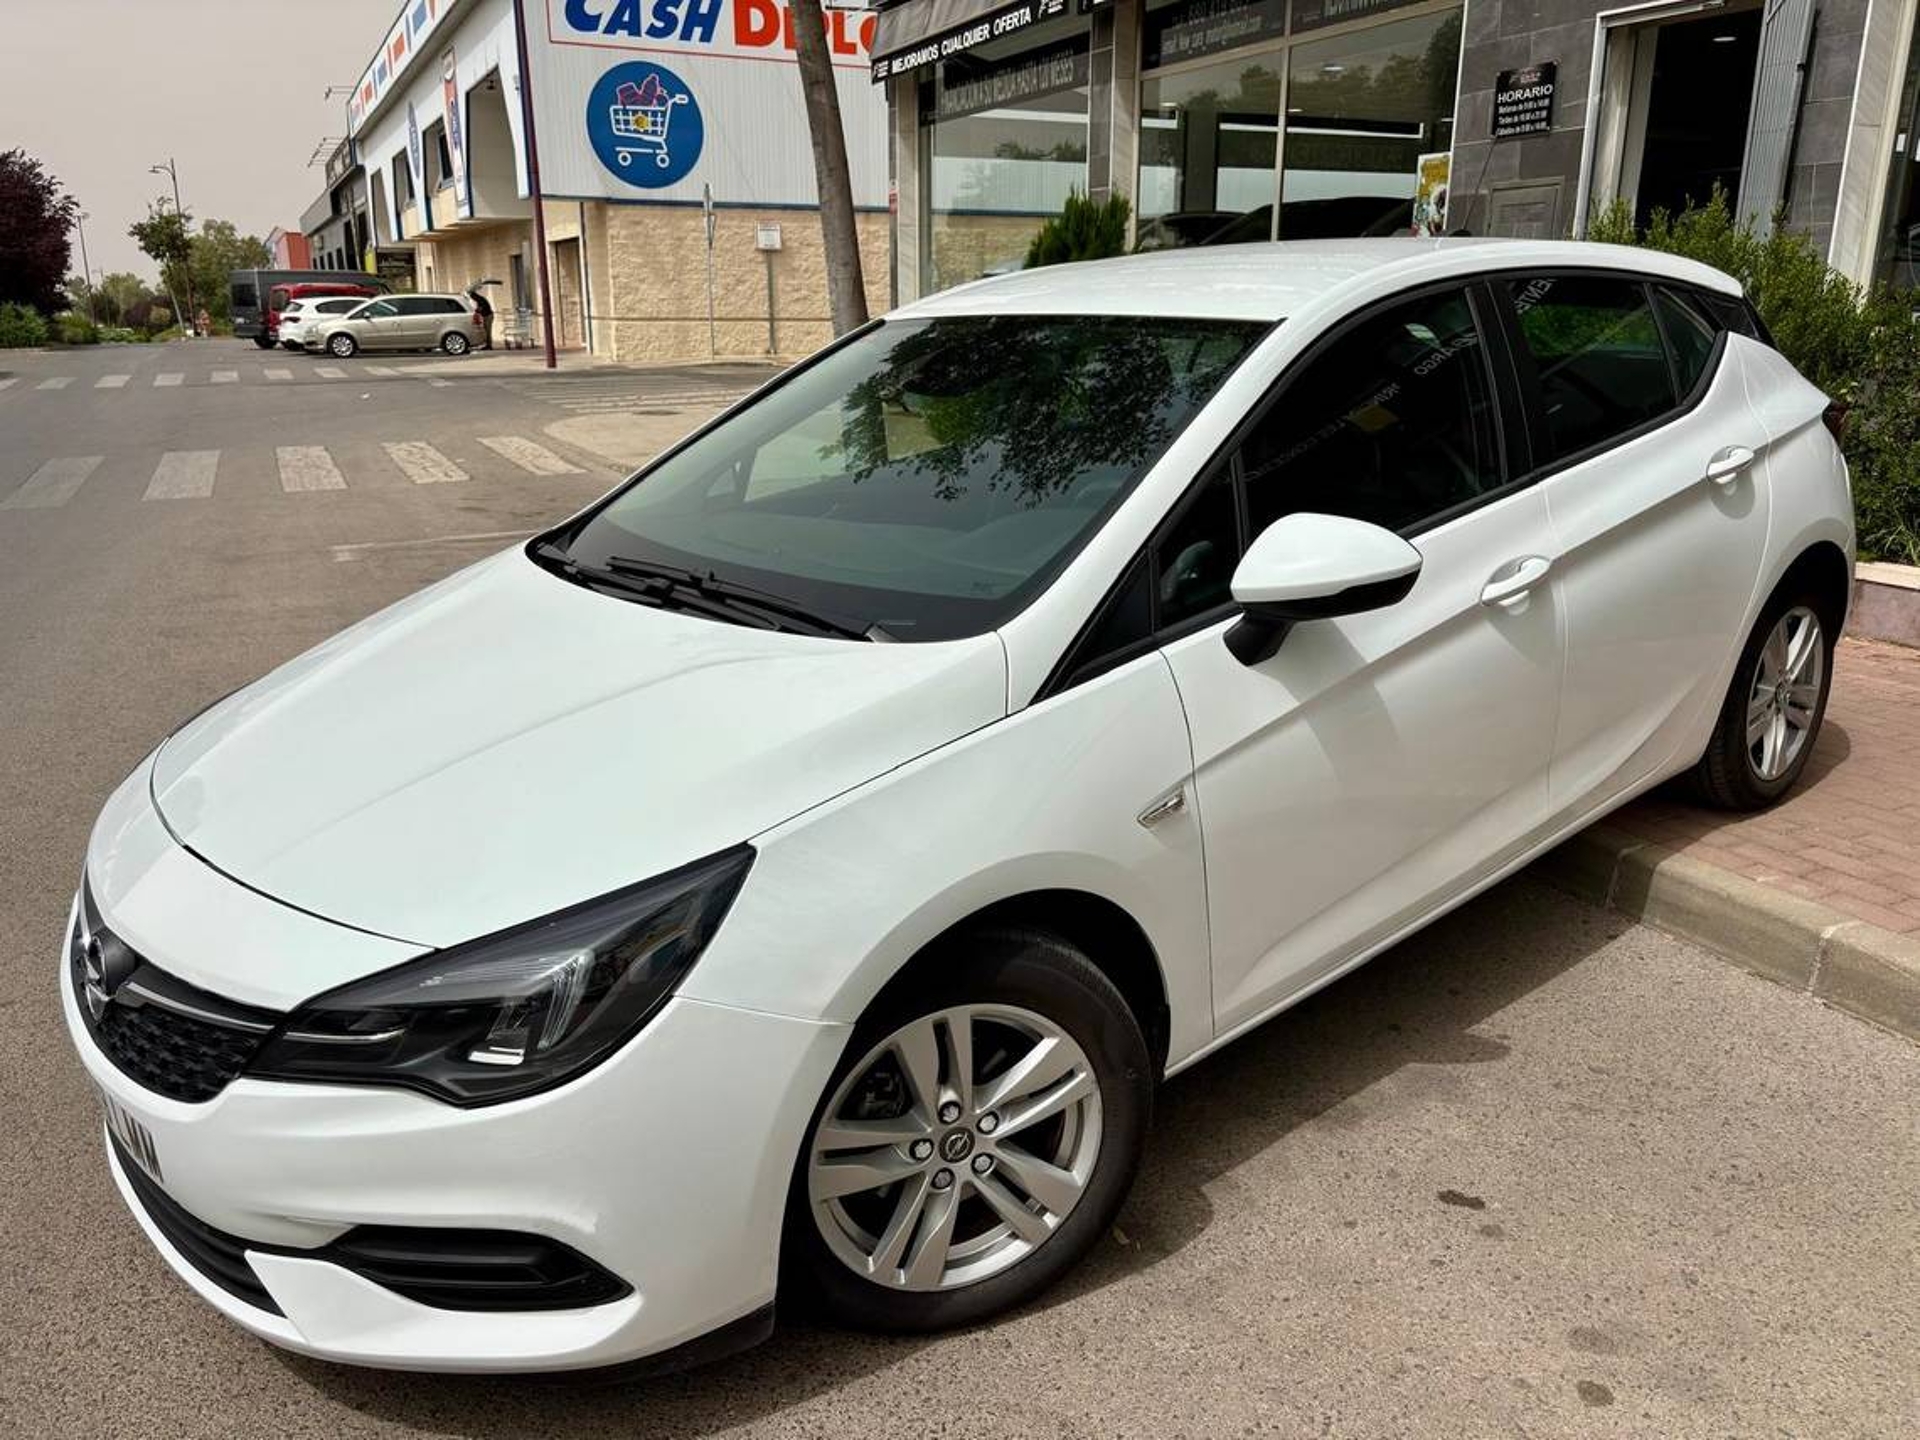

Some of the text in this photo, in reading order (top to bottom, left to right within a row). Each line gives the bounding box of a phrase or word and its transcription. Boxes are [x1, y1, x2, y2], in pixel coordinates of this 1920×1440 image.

[564, 0, 719, 43] CASH
[892, 43, 939, 74] MEJORAMOS
[941, 24, 990, 55] CUALQUIER
[993, 6, 1032, 36] OFERTA
[1497, 83, 1553, 103] HORARIO
